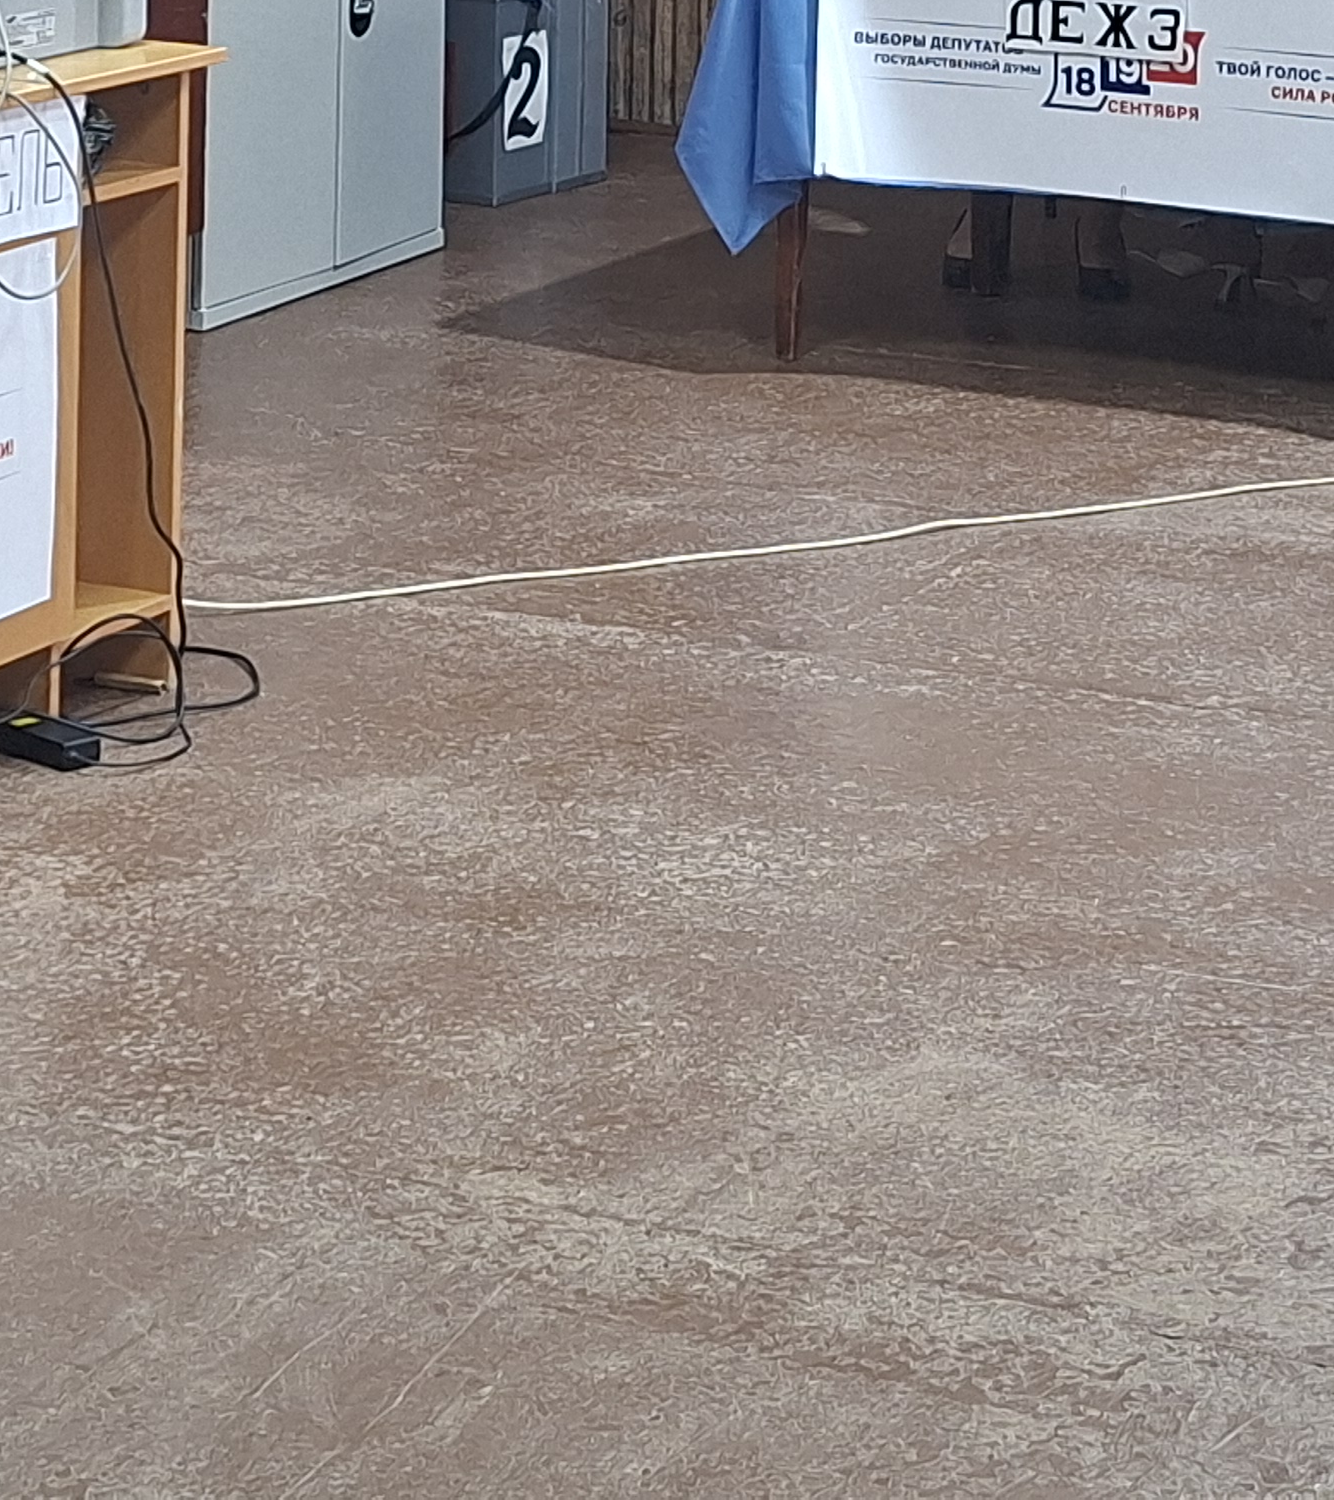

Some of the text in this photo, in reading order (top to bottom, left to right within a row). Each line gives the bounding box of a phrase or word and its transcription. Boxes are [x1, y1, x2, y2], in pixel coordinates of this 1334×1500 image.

[854, 31, 1024, 54] ВЫБОРЫ ДЕПУТАТ
[874, 53, 1041, 75] ГОСУДАРСТВЕННОЙ ДУМЫ
[1215, 60, 1261, 78] ТВОЙ
[1266, 64, 1322, 82] ГОЛОС
[1061, 66, 1095, 96] 18
[1107, 57, 1141, 84] 19
[507, 46, 541, 141] 2
[1271, 86, 1316, 104] СИЛА
[1108, 100, 1199, 121] СЕНТЯБРЯ
